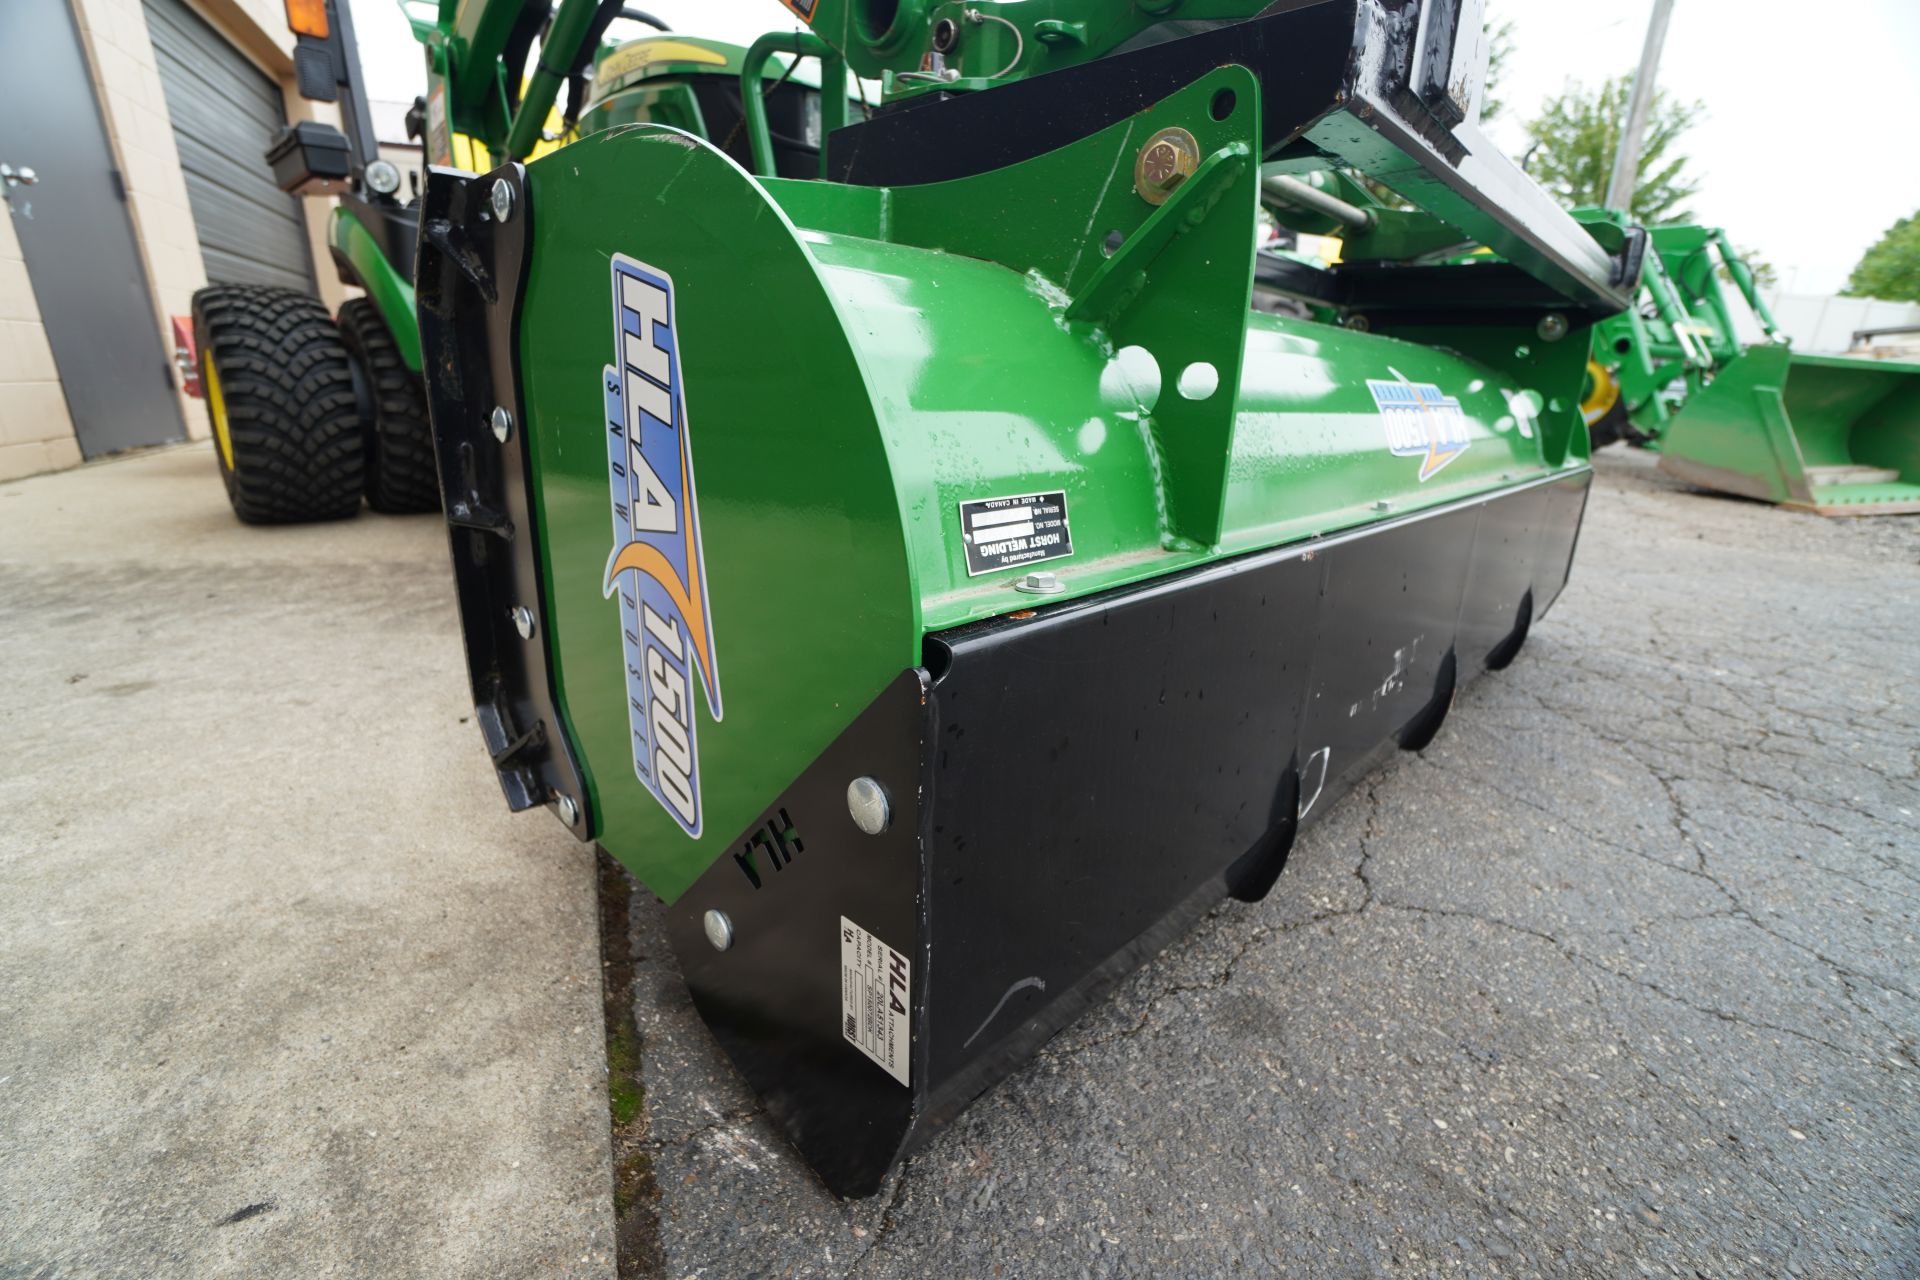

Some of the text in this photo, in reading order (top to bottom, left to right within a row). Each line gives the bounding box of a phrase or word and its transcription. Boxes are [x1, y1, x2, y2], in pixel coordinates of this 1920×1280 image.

[1383, 407, 1429, 449] 1500
[986, 496, 1037, 509] MADE IN CANADA
[1043, 505, 1060, 515] SERIAL
[1045, 519, 1061, 528] MODEL
[622, 270, 696, 828] HLA 1500
[980, 533, 1060, 557] HORST WELDING
[1001, 549, 1046, 563] Manufactured by
[607, 380, 650, 779] SNOW PUSHER
[733, 807, 804, 890] HLA
[887, 950, 907, 1069] HLA ATTACHMENTS
